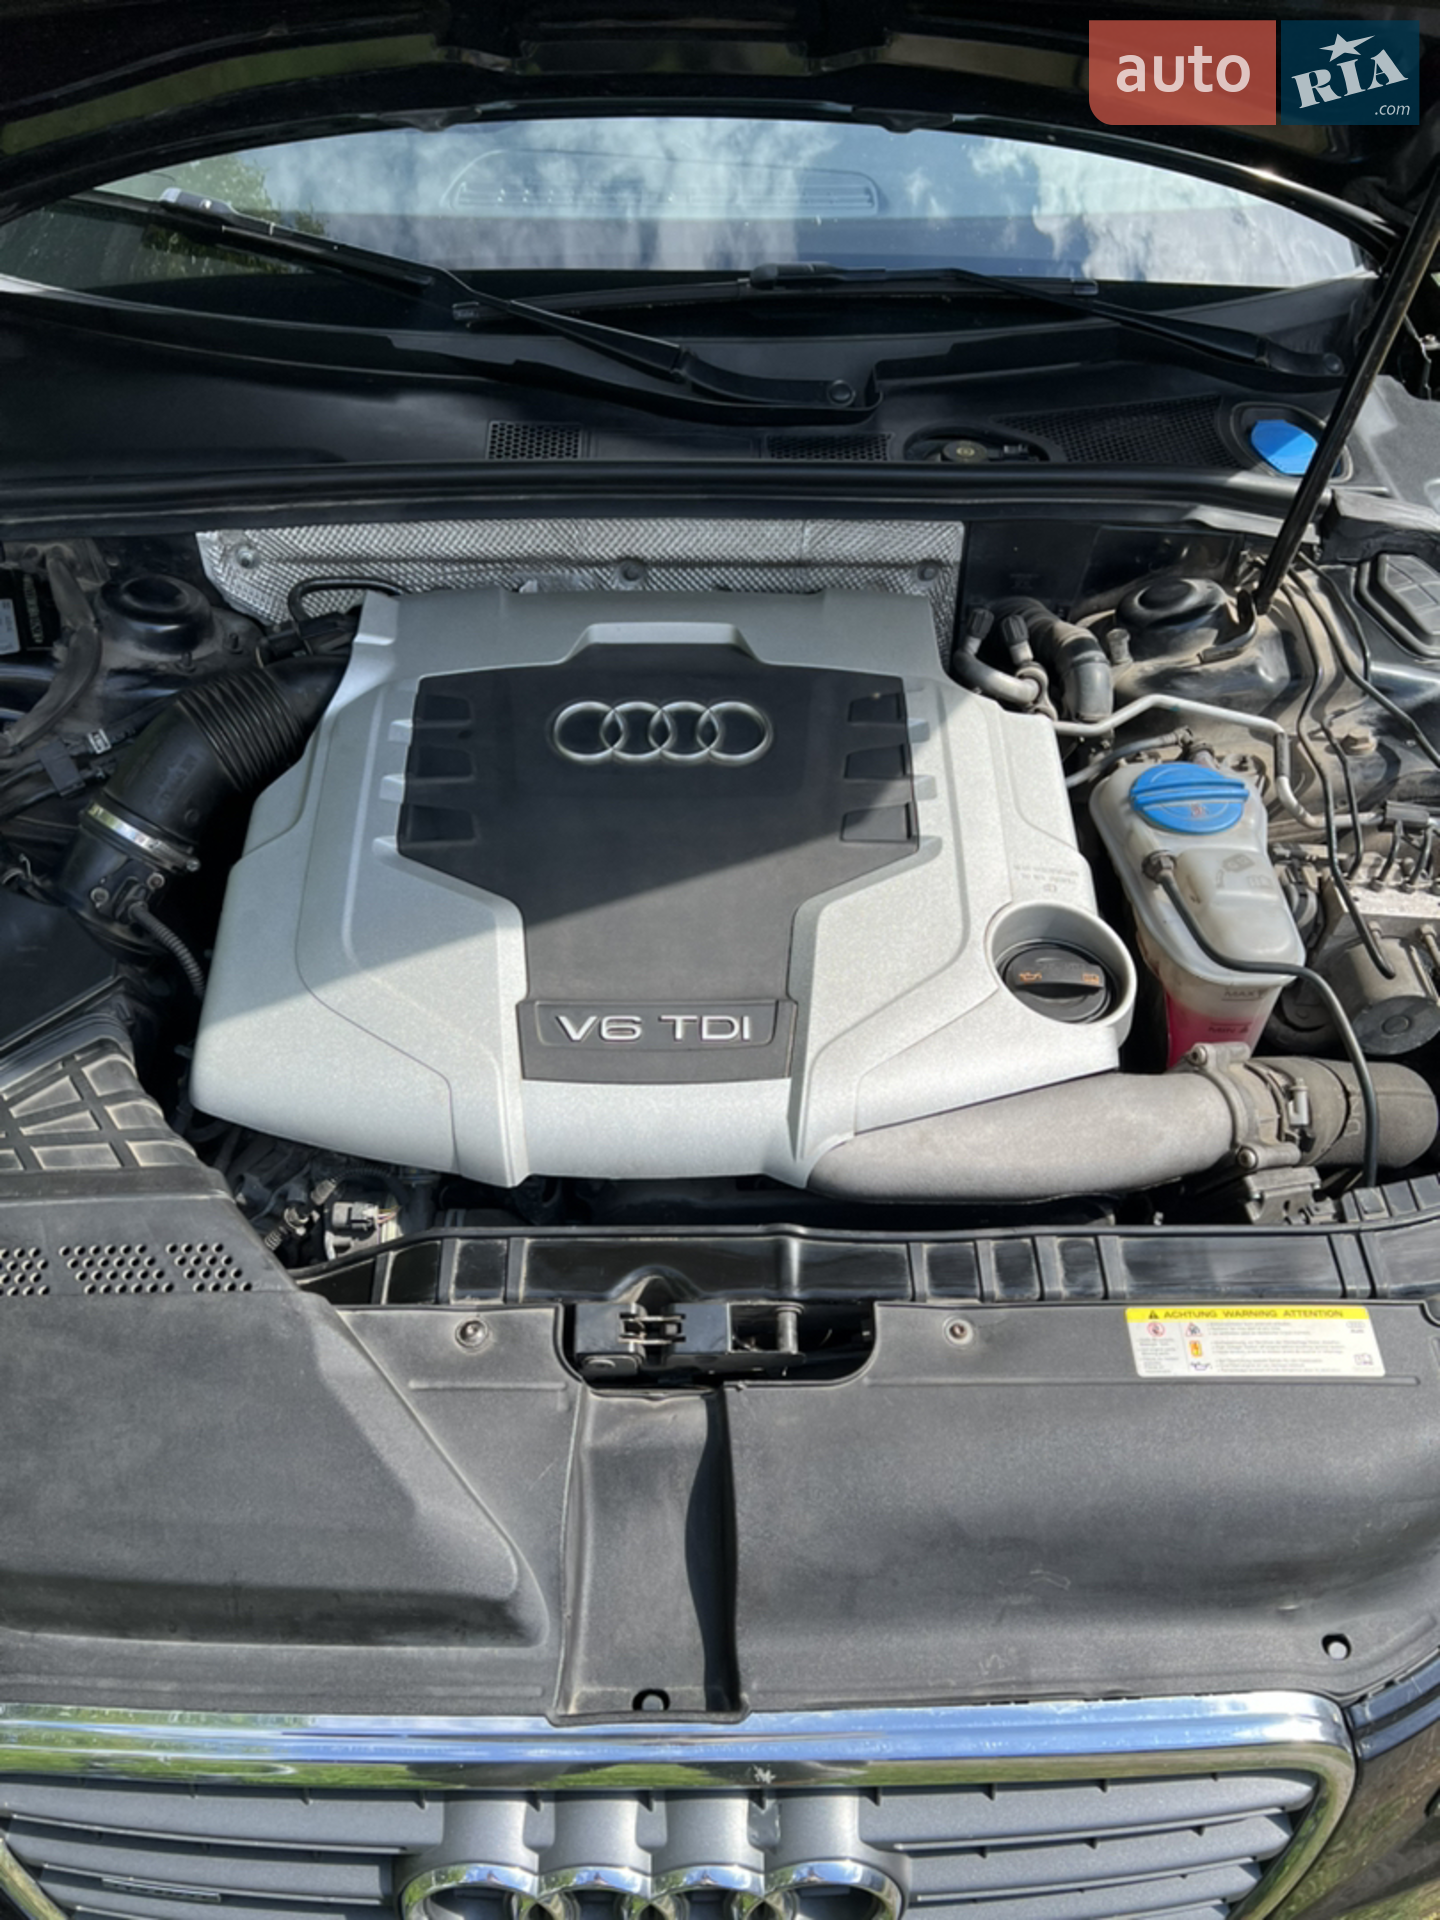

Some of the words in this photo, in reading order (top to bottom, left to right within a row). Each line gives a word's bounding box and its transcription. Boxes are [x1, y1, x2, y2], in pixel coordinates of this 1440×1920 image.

[1224, 989, 1255, 998] MAX
[556, 1015, 643, 1042] V6
[658, 1015, 751, 1042] TDI
[1208, 1026, 1236, 1034] MIN
[1163, 1310, 1218, 1319] ACHTUNG
[1222, 1310, 1277, 1318] WARNING
[1282, 1309, 1344, 1318] ATTENTION
